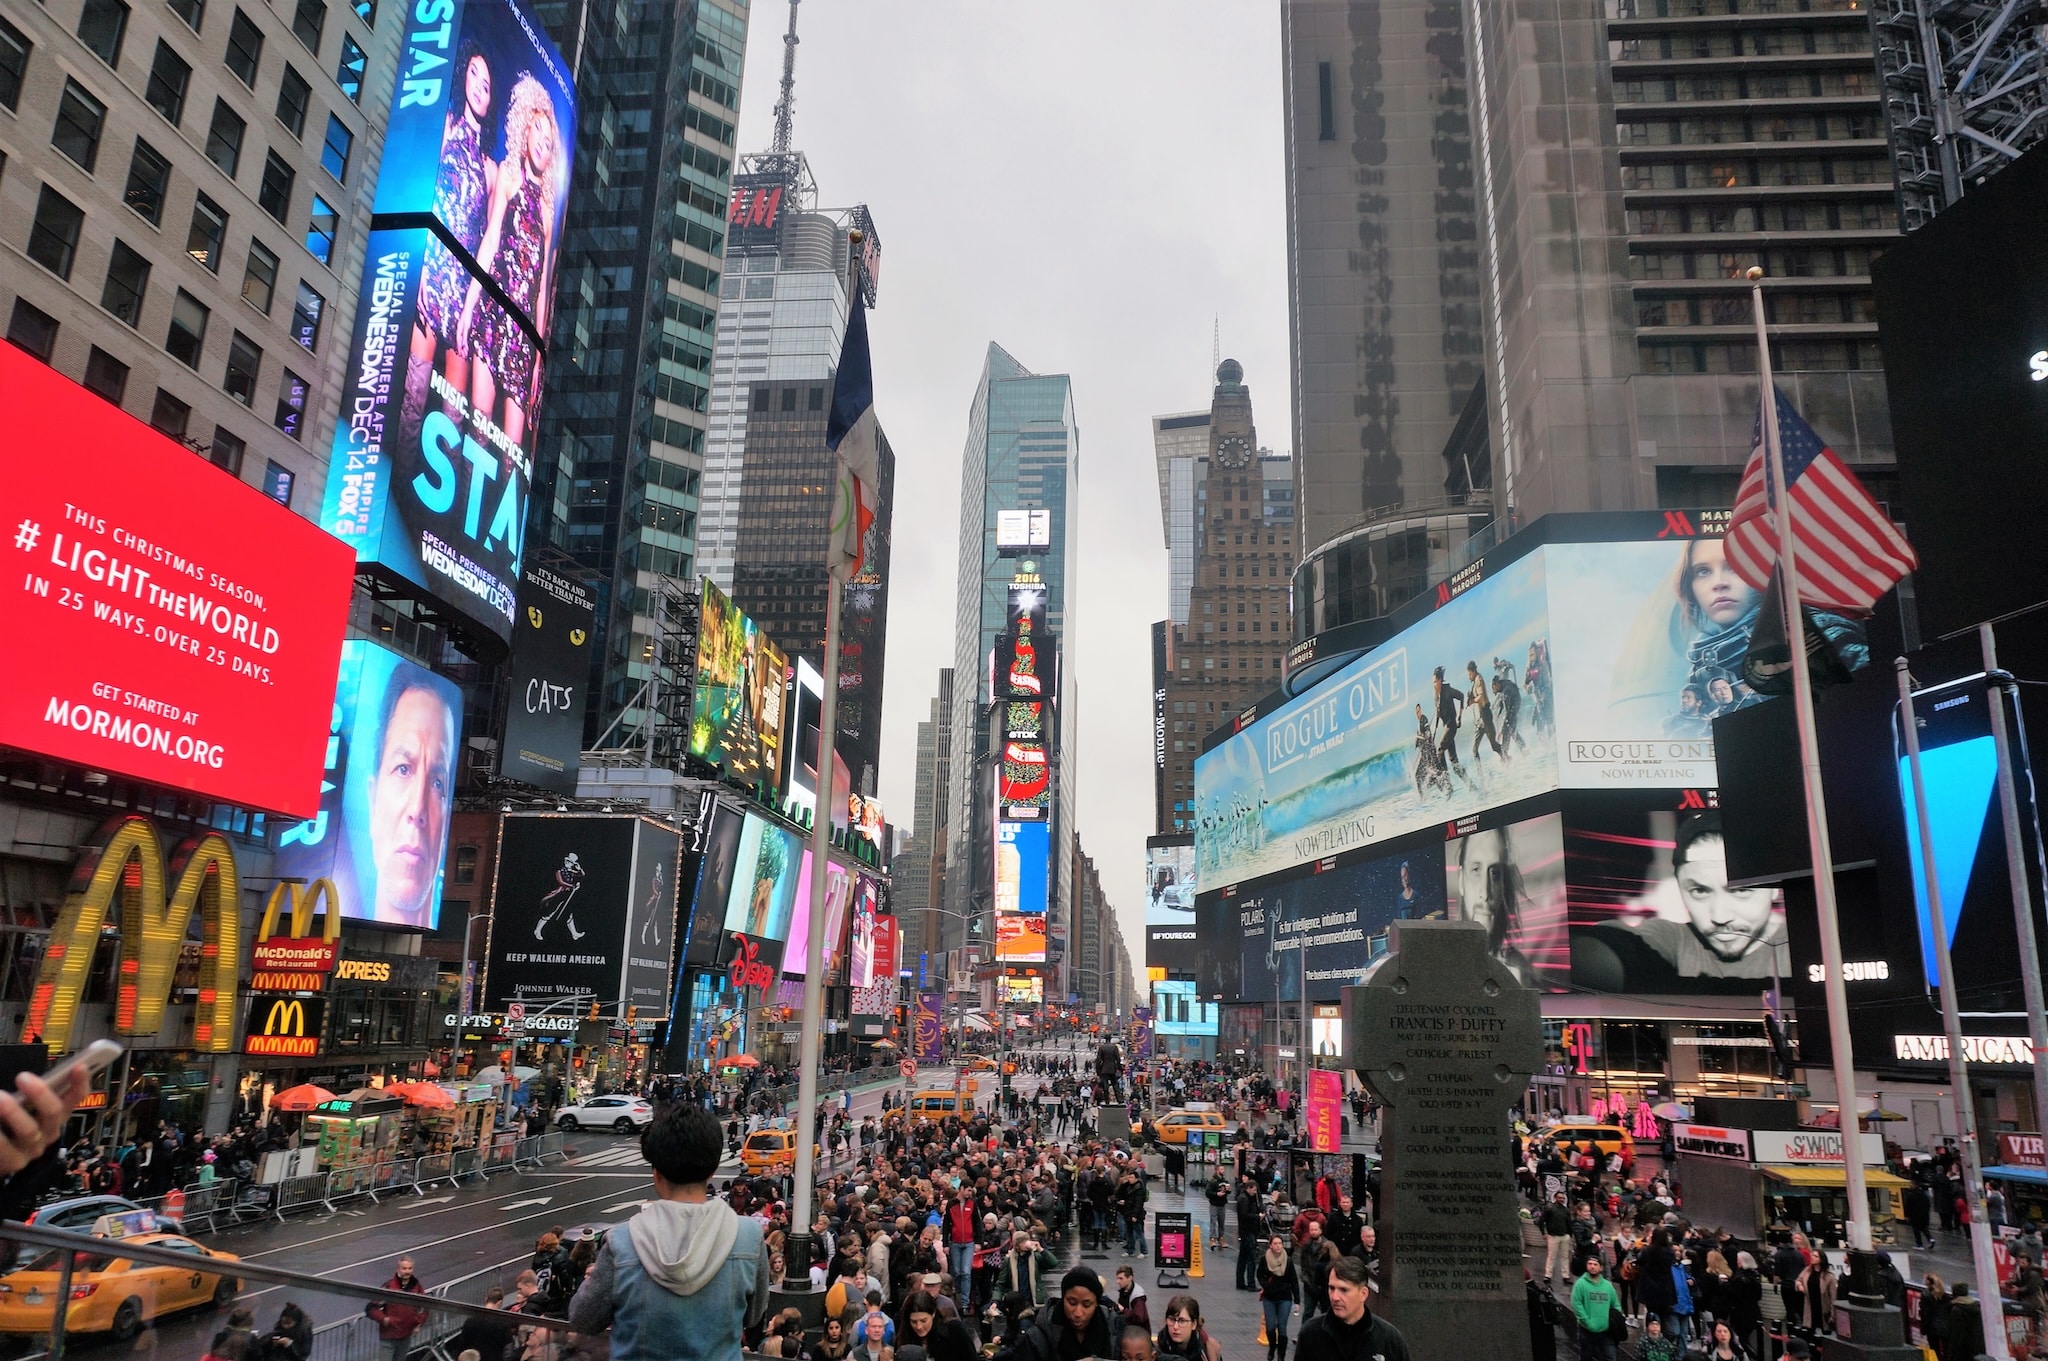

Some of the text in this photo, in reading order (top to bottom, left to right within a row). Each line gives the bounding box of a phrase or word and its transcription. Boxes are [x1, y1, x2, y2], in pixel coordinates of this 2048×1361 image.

[400, 0, 455, 108] STAR
[336, 253, 398, 535] WEDNESDAY DEC 14 FOX 5
[355, 251, 410, 534] SPECIAL PREMIERE AFTER EMPIRE
[430, 369, 524, 469] MUSIC. SACRIFICE
[64, 503, 267, 613] THIS CHRISTMAS SEASON,
[422, 530, 497, 587] SPECIAL PREMIERE
[421, 541, 490, 600] WEDNESDAY
[1014, 573, 1041, 583] 2016
[1451, 558, 1484, 584] MARRIOTT
[538, 567, 586, 597] IT'S BACK AND
[1452, 572, 1481, 597] MARQUIS
[554, 585, 574, 601] THAN
[23, 573, 274, 685] IN 25 WAYS. OVER 25 DAYS.
[92, 681, 199, 726] GET STARTED AT
[526, 678, 573, 714] CATS
[1934, 696, 1970, 711] SAMSUNG
[1272, 661, 1401, 762] ROGUE ONE
[44, 697, 224, 769] MORMON.ORG
[1576, 744, 1715, 759] ROGUE ONE
[1602, 769, 1696, 778] NOW PLAYING
[1295, 816, 1375, 860] NOW PLAYING
[1241, 909, 1265, 927] POLARIS
[1284, 921, 1292, 933] for
[1345, 908, 1358, 923] and
[255, 947, 332, 960] McDonald's
[506, 953, 606, 965] KEEP WALKING AMERICA
[266, 960, 317, 968] Restaurant
[514, 984, 592, 995] JOHNNIE WALKER
[1396, 1004, 1496, 1016] LIEUTENANT COLONEL
[502, 1015, 580, 1031] LGGAGE
[914, 992, 937, 1057] Aladdin
[1390, 1017, 1506, 1031] FRANCIS DUFFY
[1397, 1033, 1415, 1042] MAY
[1405, 1049, 1493, 1060] CATHOLIC PRIEST
[1427, 1073, 1473, 1083] CHAPLAIN
[1410, 1126, 1498, 1136] A LIFE OF SERVICE
[1406, 1146, 1501, 1155] GOD AND COUNTRY
[1676, 1136, 1746, 1158] SANDWICHES
[1441, 1171, 1485, 1179] AMERICAN
[1417, 1183, 1439, 1192] YORK
[1442, 1183, 1482, 1192] NATIONAL
[1427, 1206, 1485, 1216] WORLD WAR
[1418, 1281, 1447, 1290] CROIX
[1451, 1281, 1464, 1290] DE
